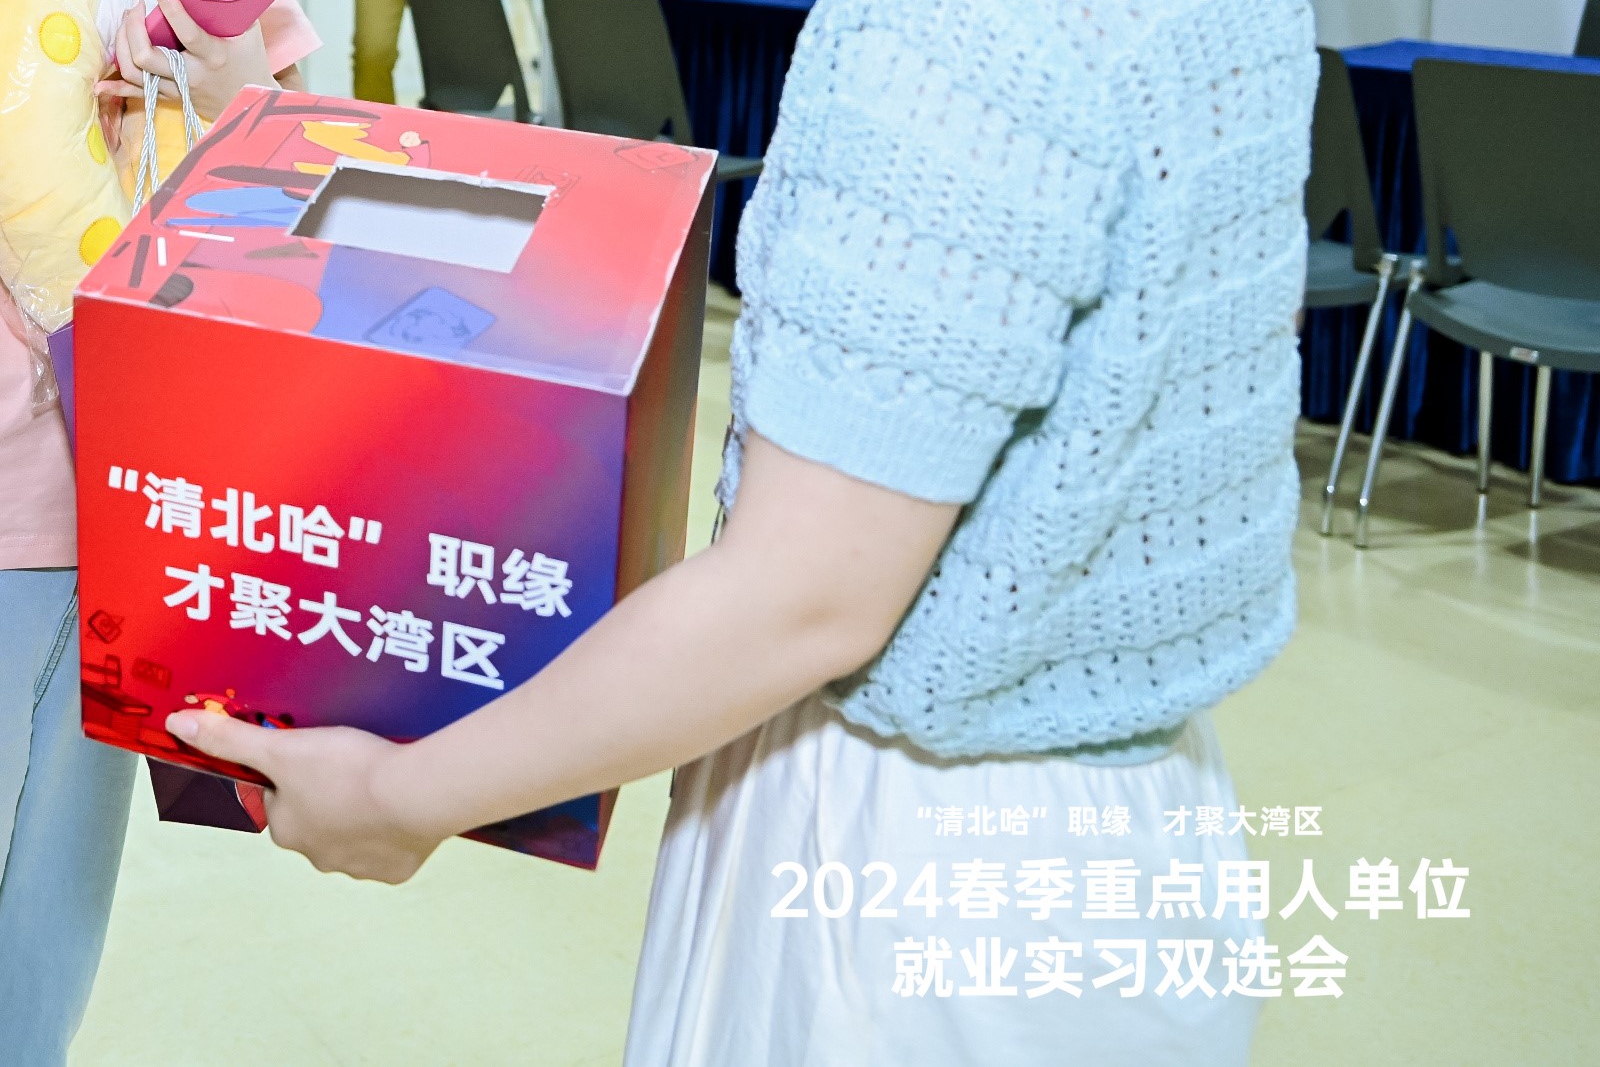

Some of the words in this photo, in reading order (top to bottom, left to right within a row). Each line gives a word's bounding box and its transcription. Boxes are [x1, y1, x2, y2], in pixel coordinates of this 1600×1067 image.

[108, 465, 383, 569] "清北哈"
[427, 532, 573, 619] 职缘
[162, 564, 507, 692] 才聚大湾区
